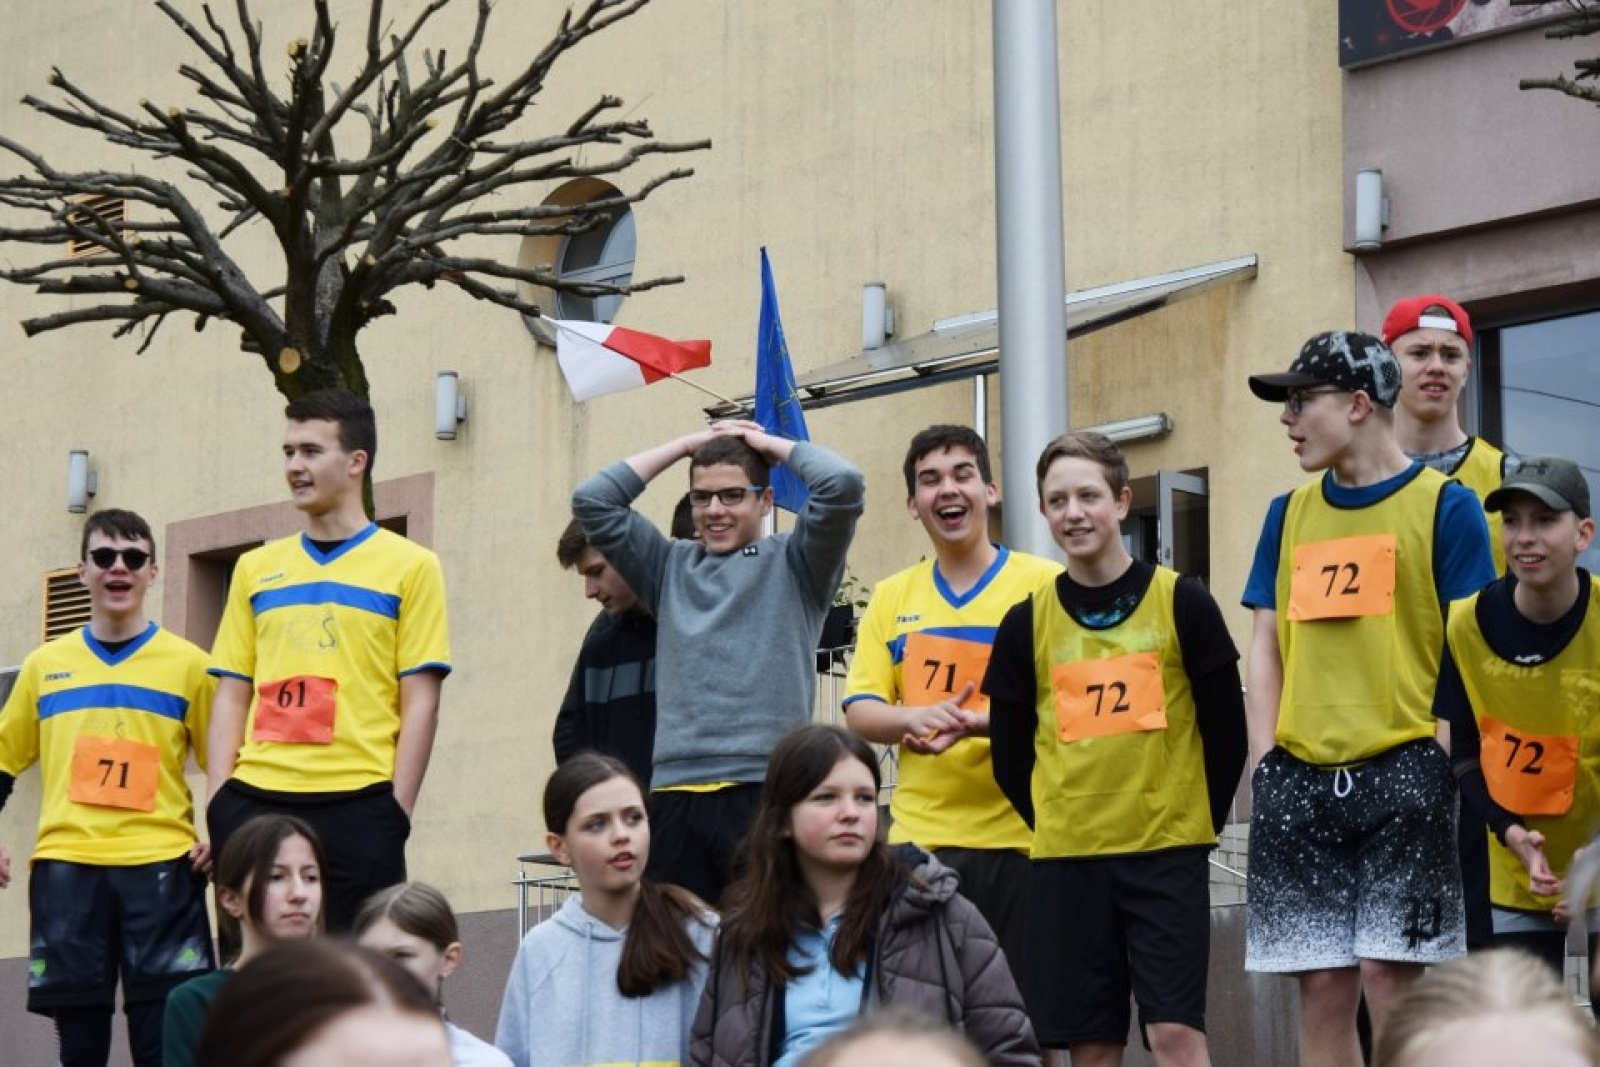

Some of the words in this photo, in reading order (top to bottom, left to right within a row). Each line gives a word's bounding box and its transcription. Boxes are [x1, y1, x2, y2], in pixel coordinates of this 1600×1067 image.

[1320, 562, 1360, 598] 72
[923, 659, 957, 693] 71
[277, 680, 306, 709] 61
[1086, 681, 1131, 717] 72
[1504, 733, 1545, 775] 72
[98, 759, 130, 789] 71
